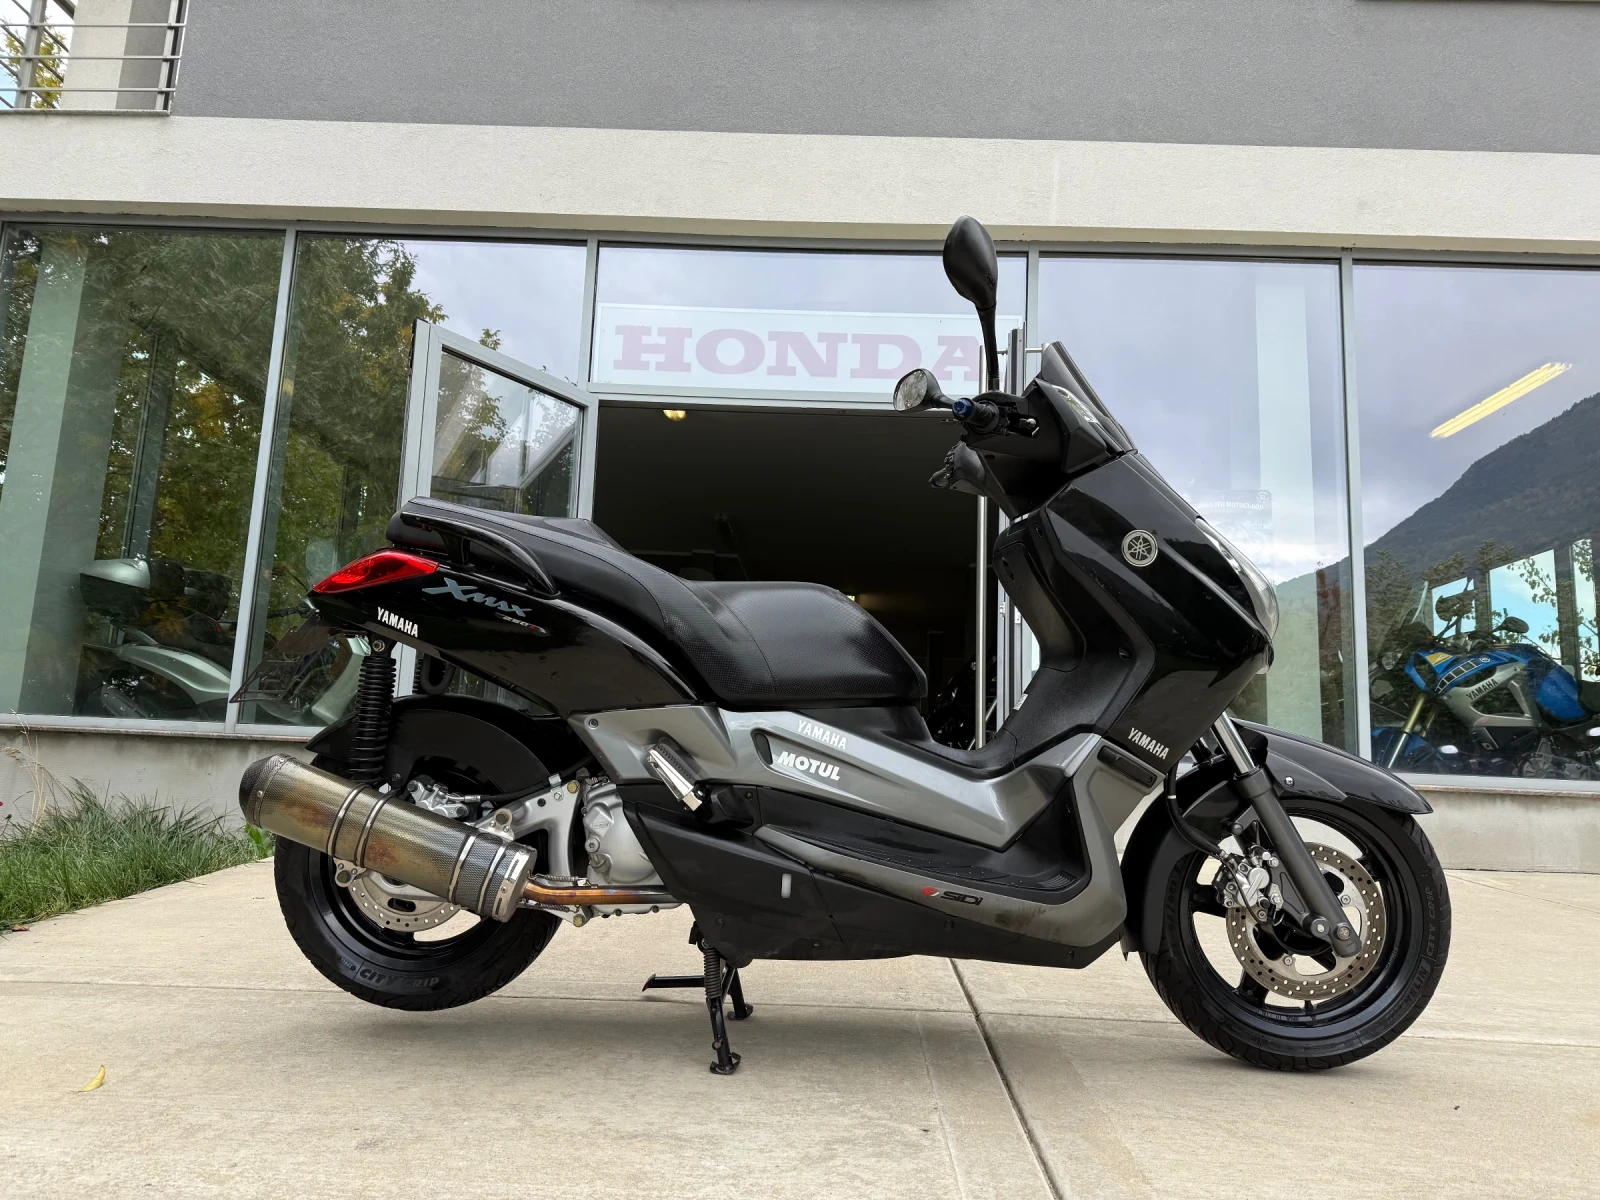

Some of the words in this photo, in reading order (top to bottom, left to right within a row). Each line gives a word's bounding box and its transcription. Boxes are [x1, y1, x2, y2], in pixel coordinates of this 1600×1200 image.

[613, 324, 1003, 383] HONDA
[377, 606, 419, 638] YAMAHA
[1466, 678, 1499, 701] YAMAHA
[797, 719, 847, 750] YAMAHA
[1127, 727, 1170, 760] YAMAHA
[777, 750, 841, 781] MOTUL
[359, 968, 398, 987] CITY
[401, 976, 441, 989] GRIP
